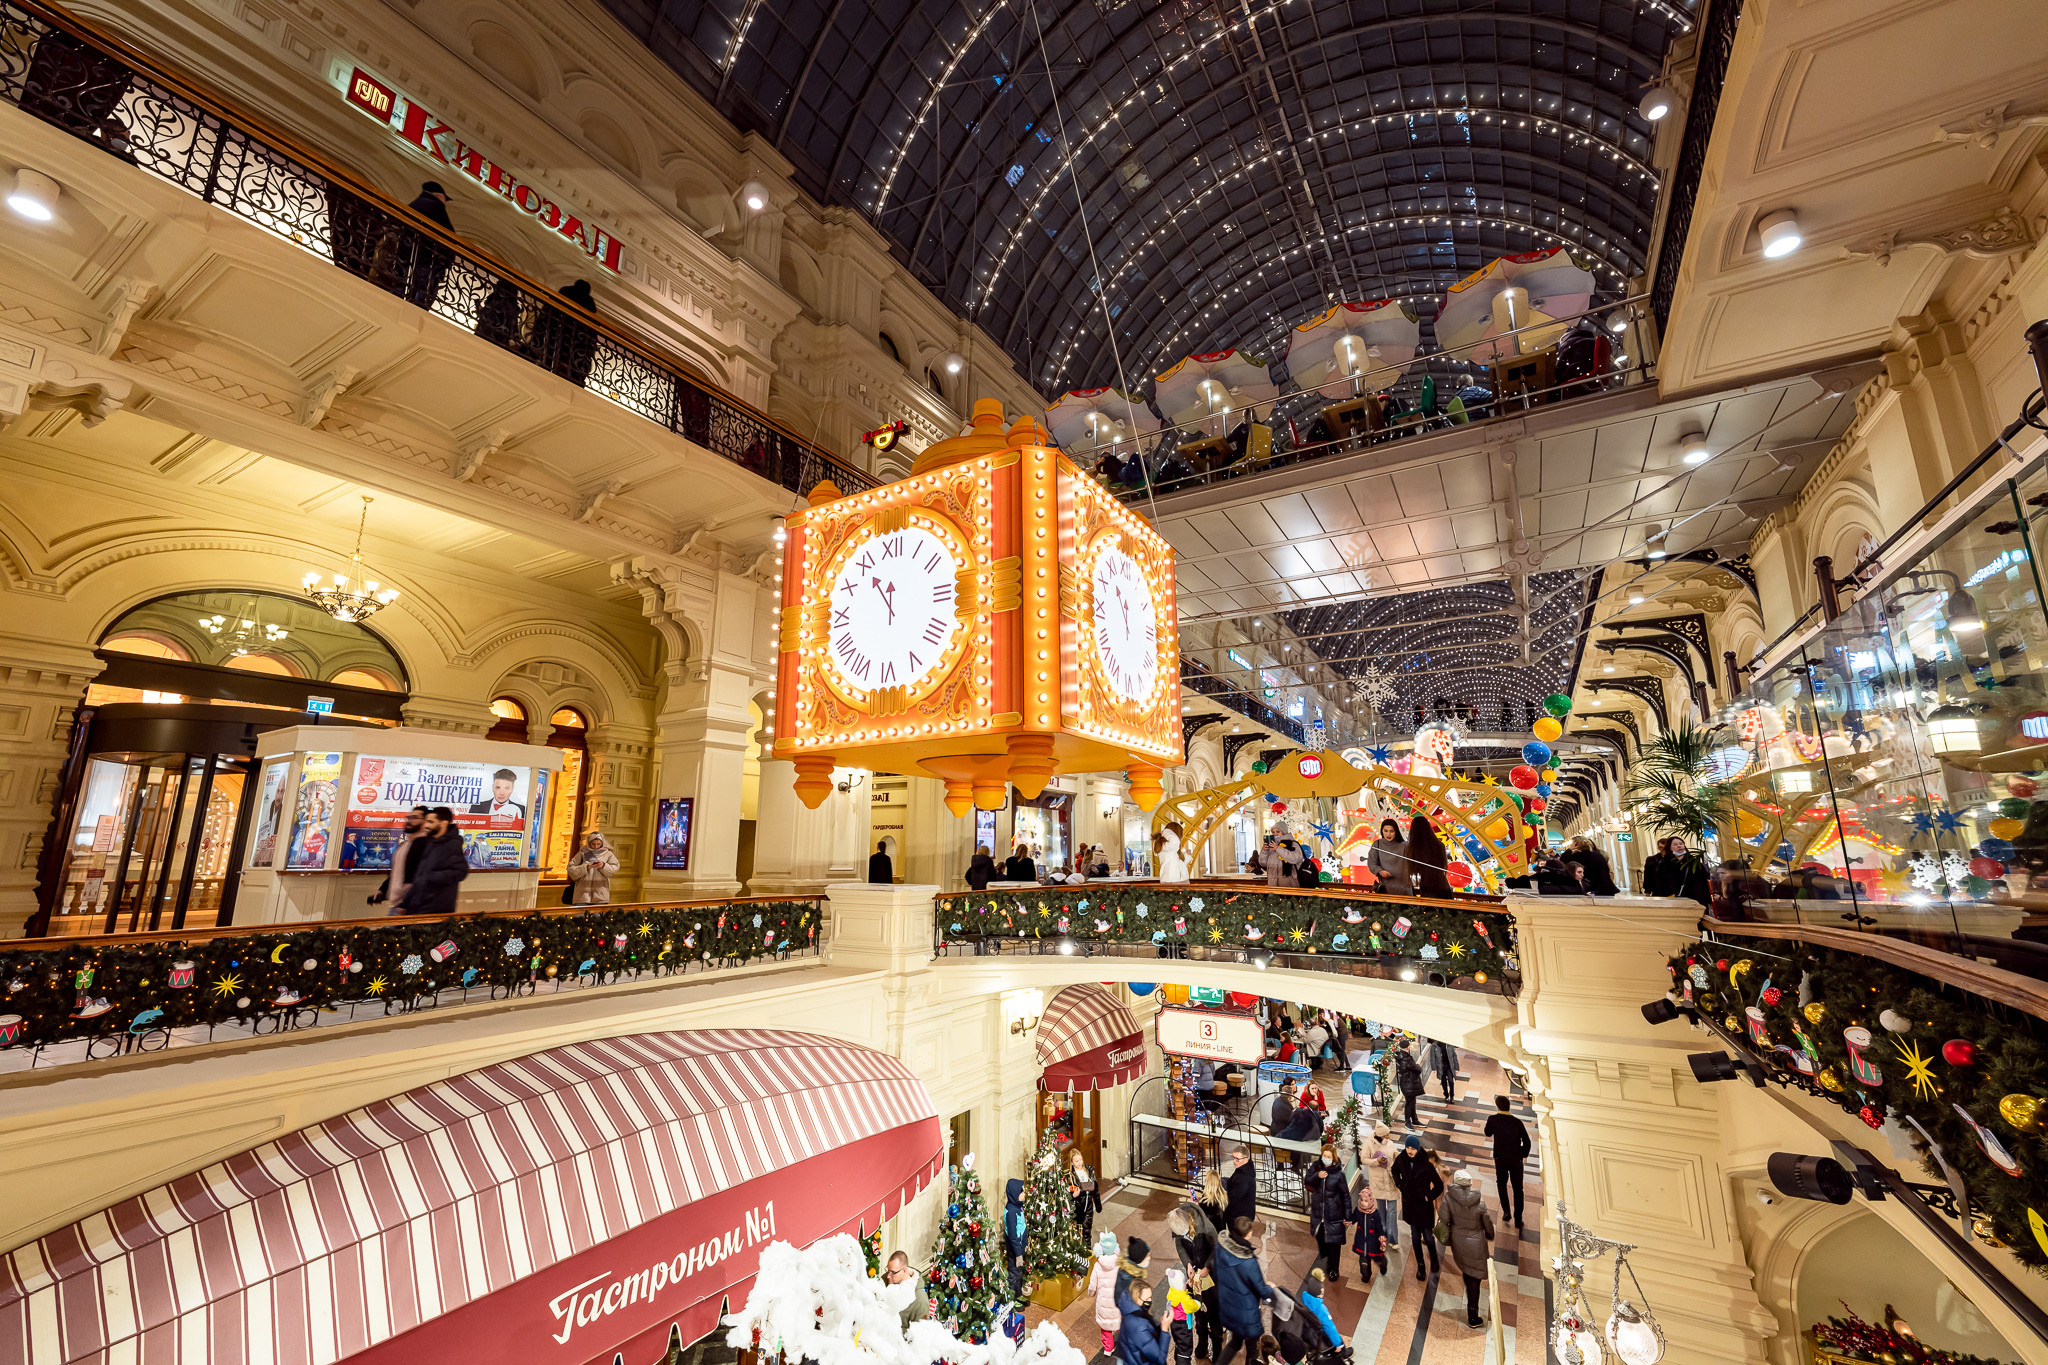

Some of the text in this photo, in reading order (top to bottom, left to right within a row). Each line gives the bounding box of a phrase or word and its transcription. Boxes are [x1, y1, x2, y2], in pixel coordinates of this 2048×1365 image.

[882, 536, 903, 560] XII
[856, 551, 875, 576] XI
[924, 553, 942, 573] II
[840, 578, 858, 596] X
[933, 584, 951, 603] III
[909, 651, 922, 672] V
[369, 761, 377, 772] 7
[416, 768, 484, 788] Валентин
[384, 782, 482, 806] ЮДАШКИН
[1204, 1024, 1213, 1037] 3
[1185, 1040, 1211, 1050] ЛИНИЯ
[1217, 1045, 1233, 1054] LINE
[549, 1227, 744, 1345] Гастроном
